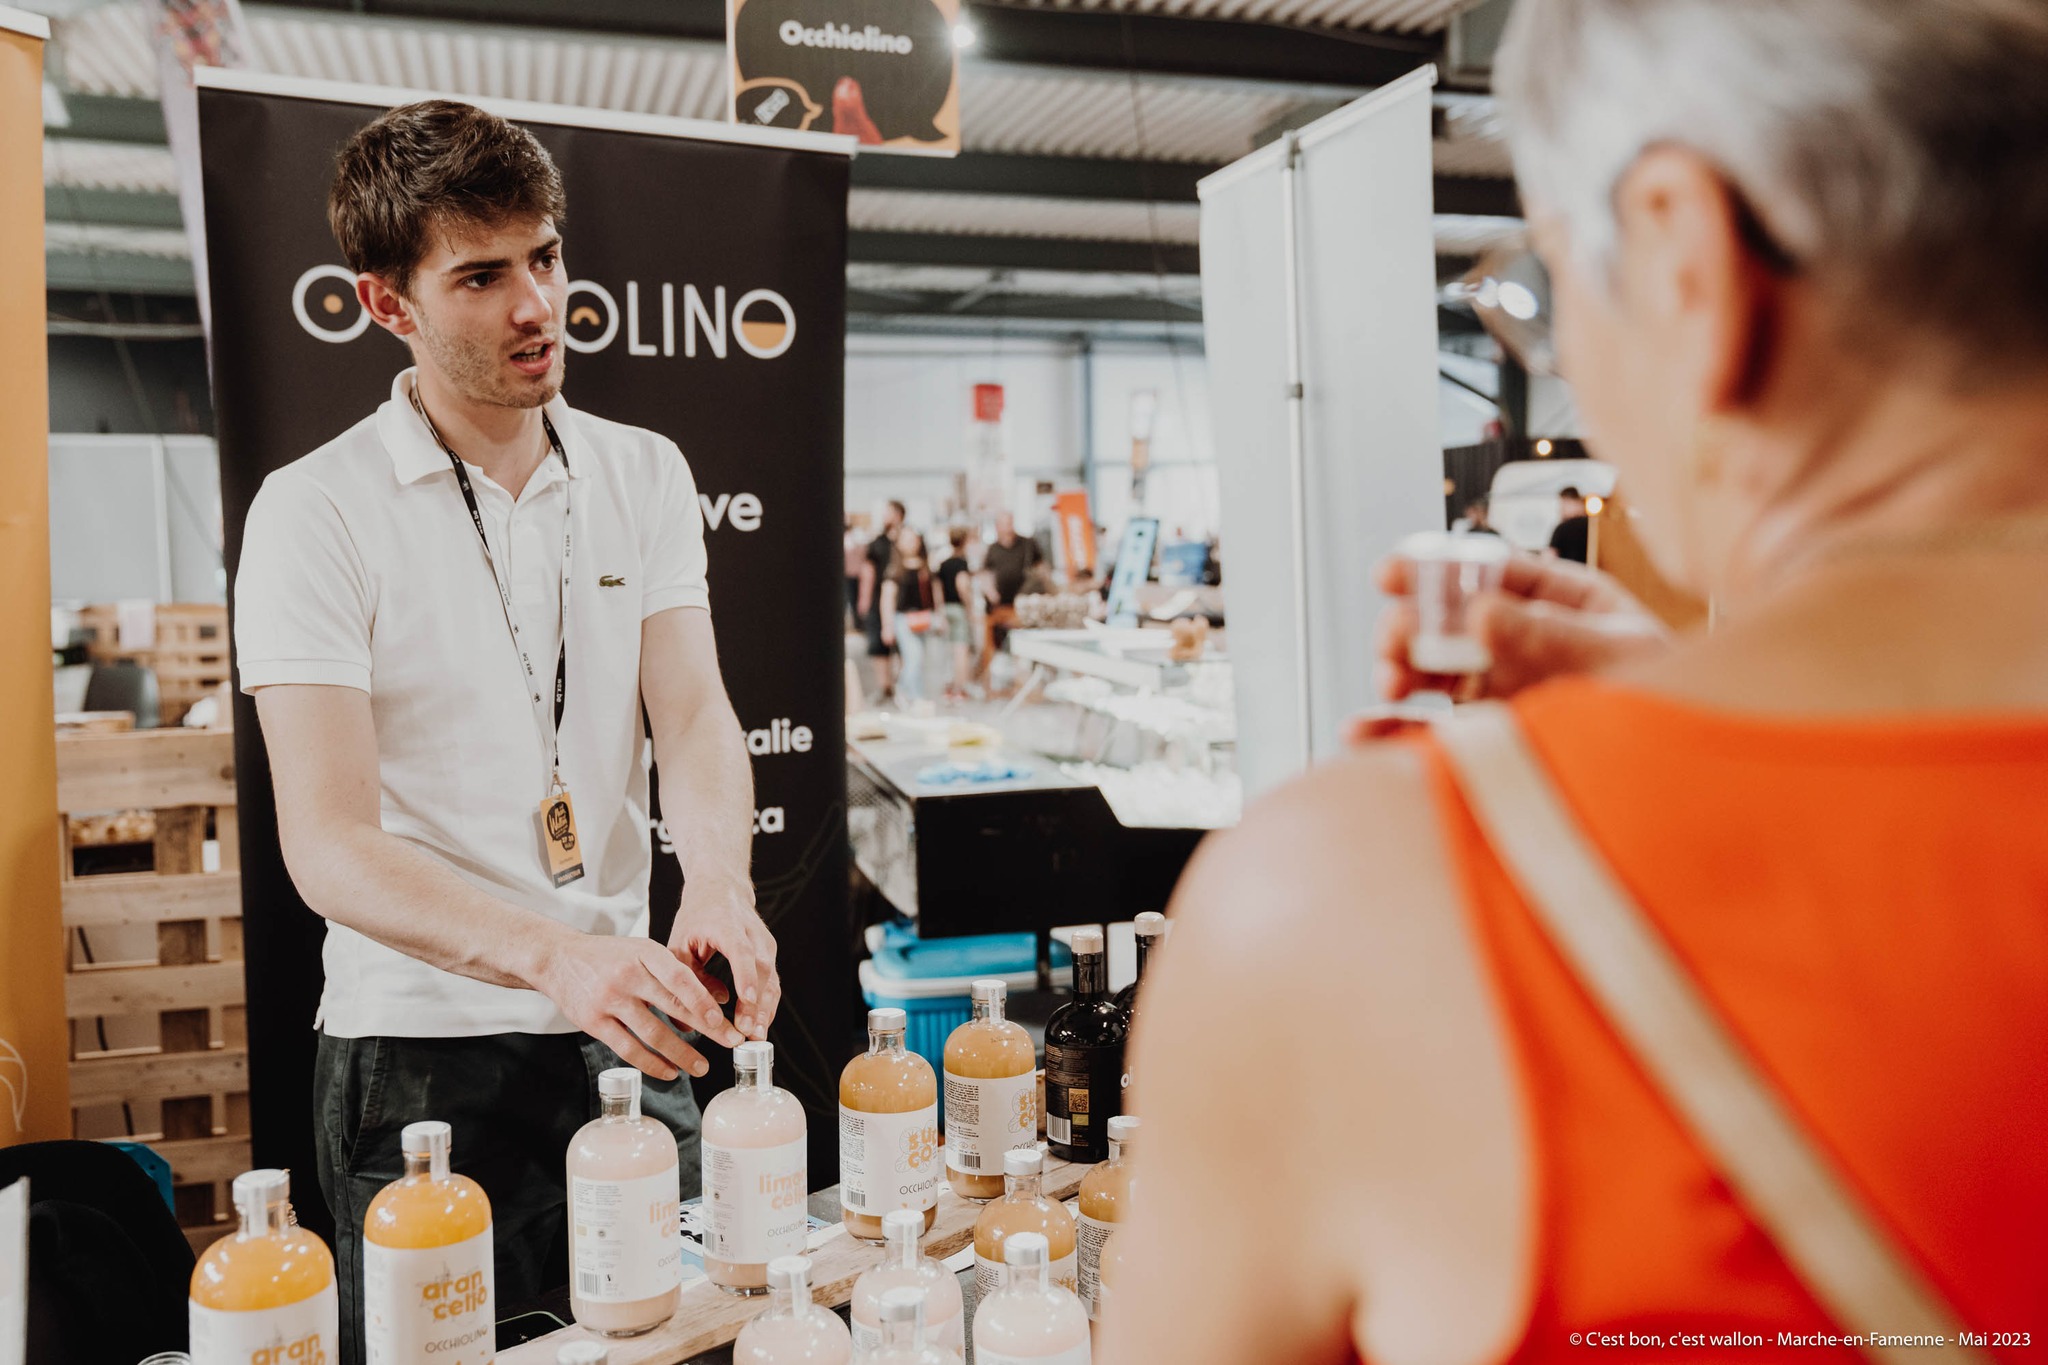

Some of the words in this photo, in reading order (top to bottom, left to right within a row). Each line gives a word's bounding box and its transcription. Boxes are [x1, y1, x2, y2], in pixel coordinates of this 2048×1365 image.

[779, 19, 913, 55] Occhiolino
[292, 263, 797, 360] OOLINO
[422, 1270, 483, 1300] aran
[432, 1285, 487, 1320] cello
[251, 1333, 321, 1365] aran
